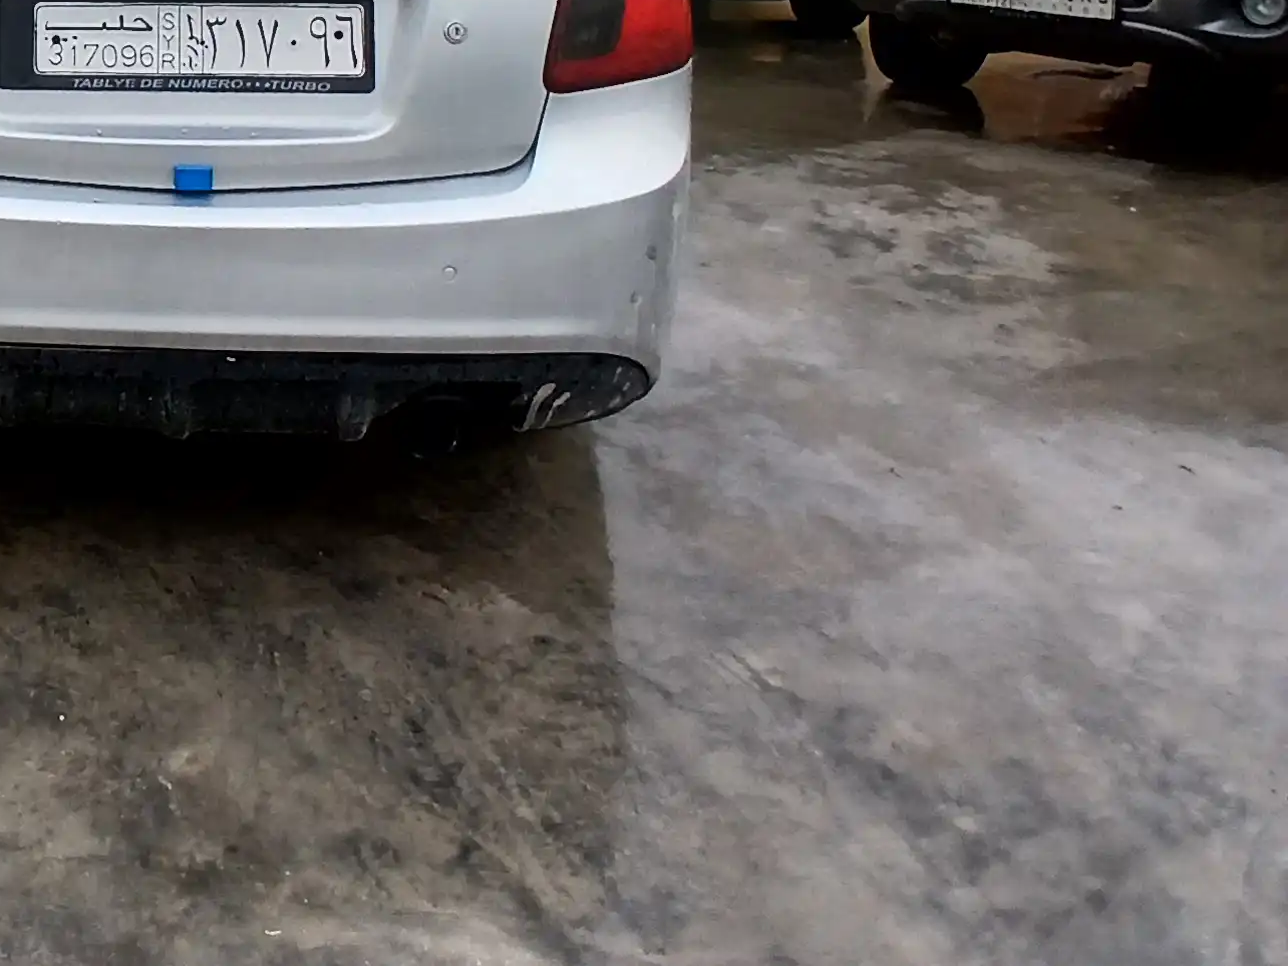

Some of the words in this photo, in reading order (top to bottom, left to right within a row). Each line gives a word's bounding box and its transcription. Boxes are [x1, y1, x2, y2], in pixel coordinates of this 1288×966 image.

[44, 14, 153, 40] حلب
[48, 43, 154, 68] 317096
[140, 78, 162, 89] DE
[168, 78, 244, 90] NUMERO
